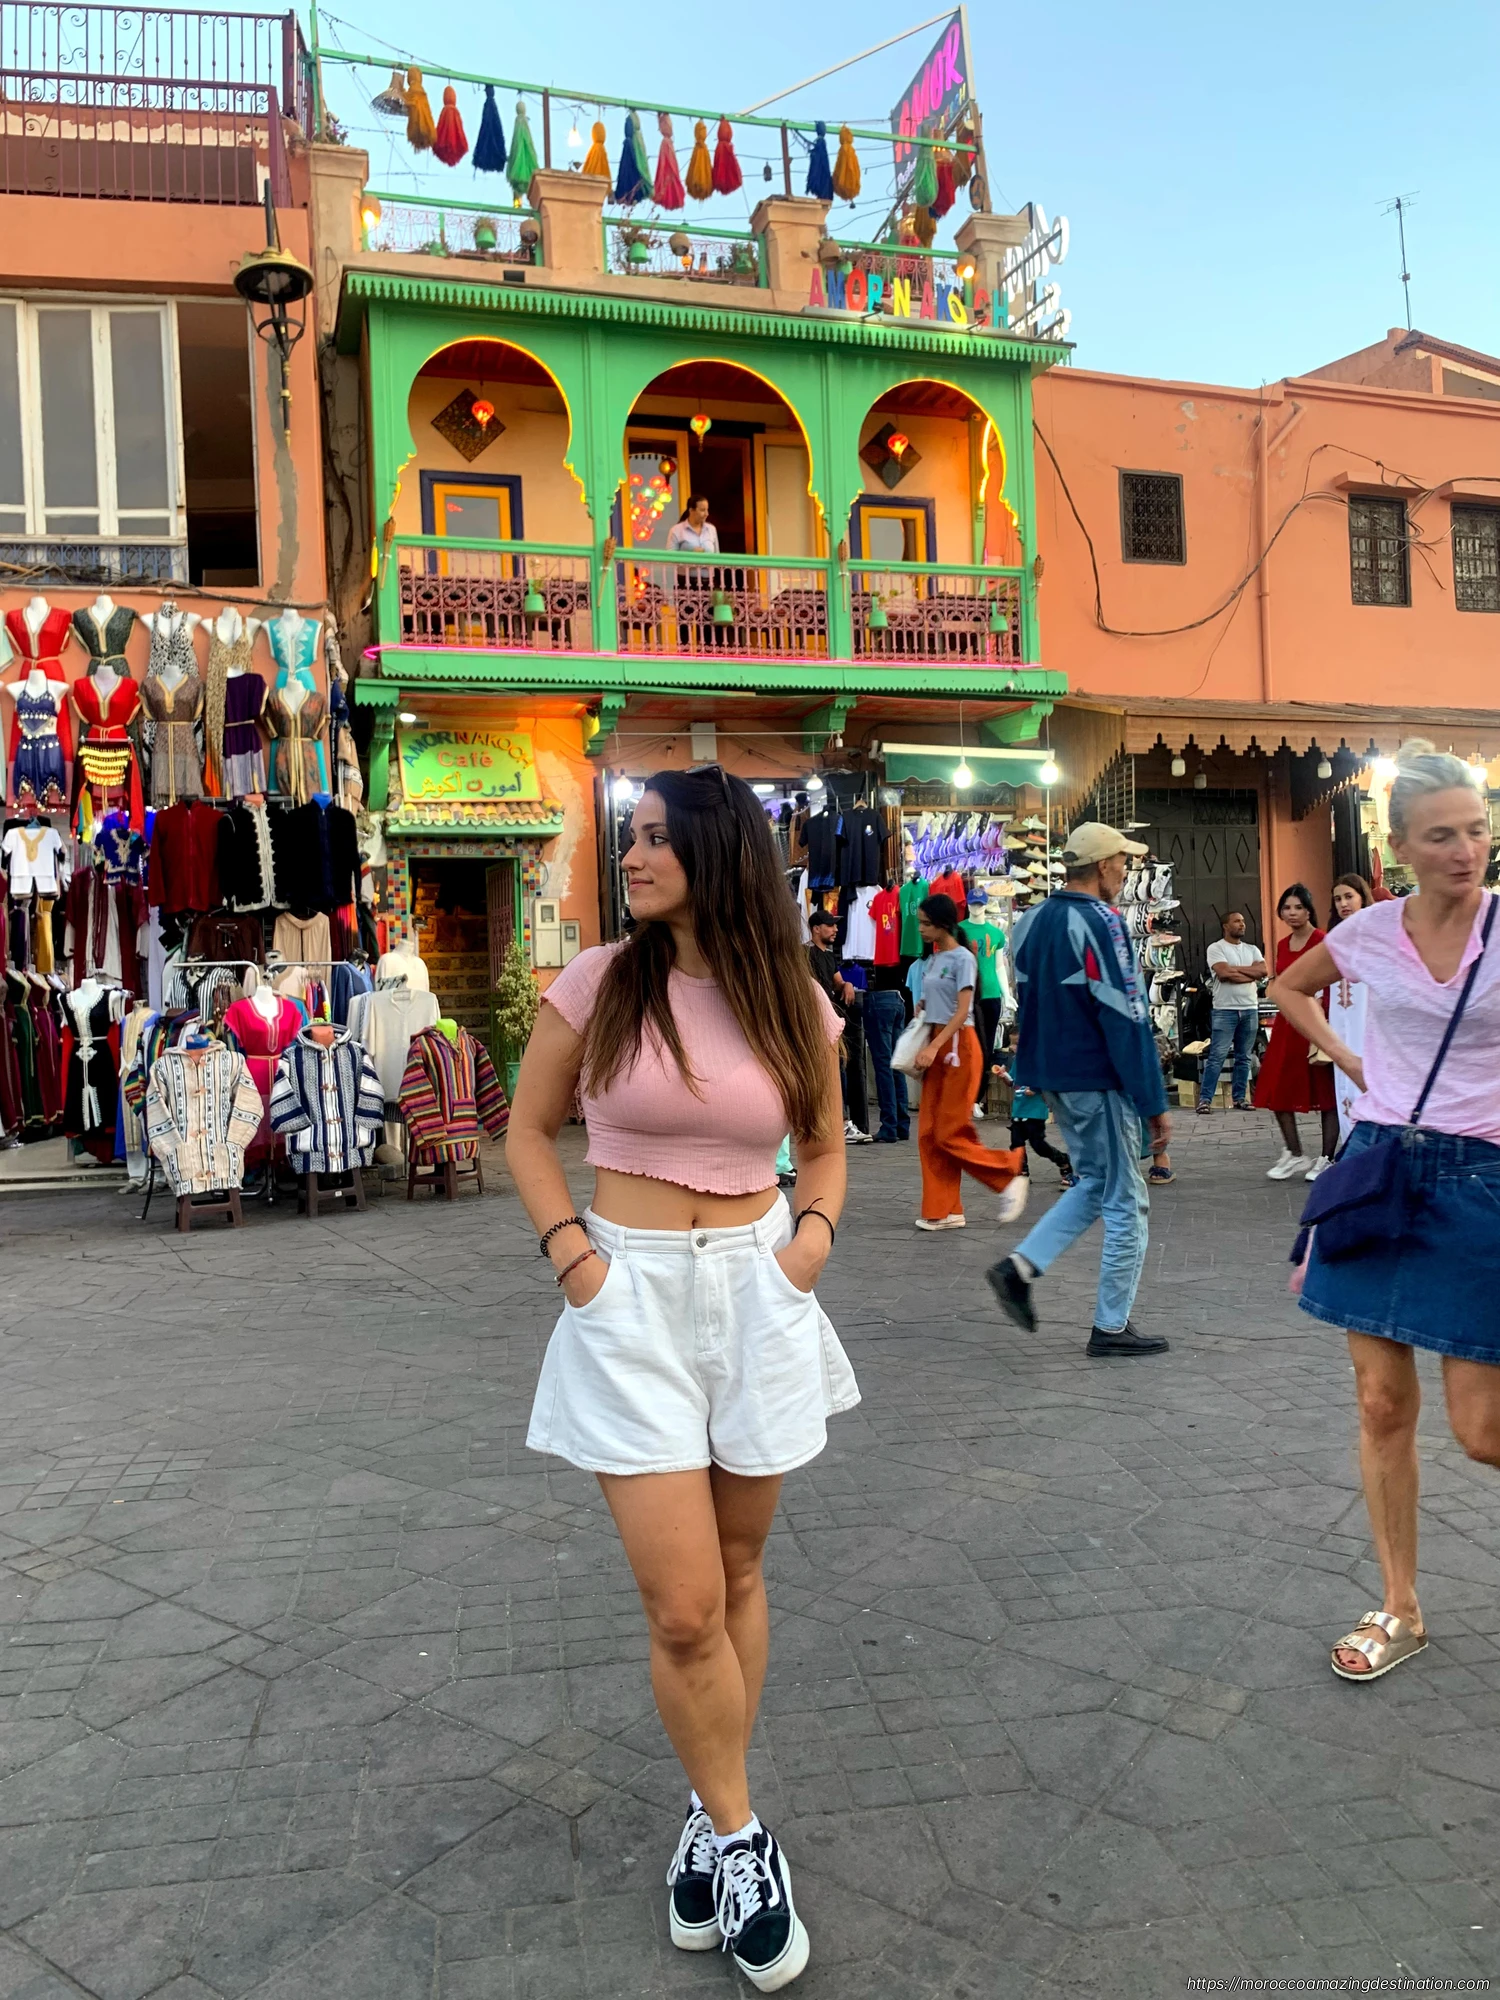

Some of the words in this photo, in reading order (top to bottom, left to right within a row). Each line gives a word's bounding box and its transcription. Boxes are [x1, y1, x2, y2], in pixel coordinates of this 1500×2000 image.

[895, 23, 963, 163] AMOR
[809, 268, 884, 313] AMOR
[437, 750, 494, 768] Café
